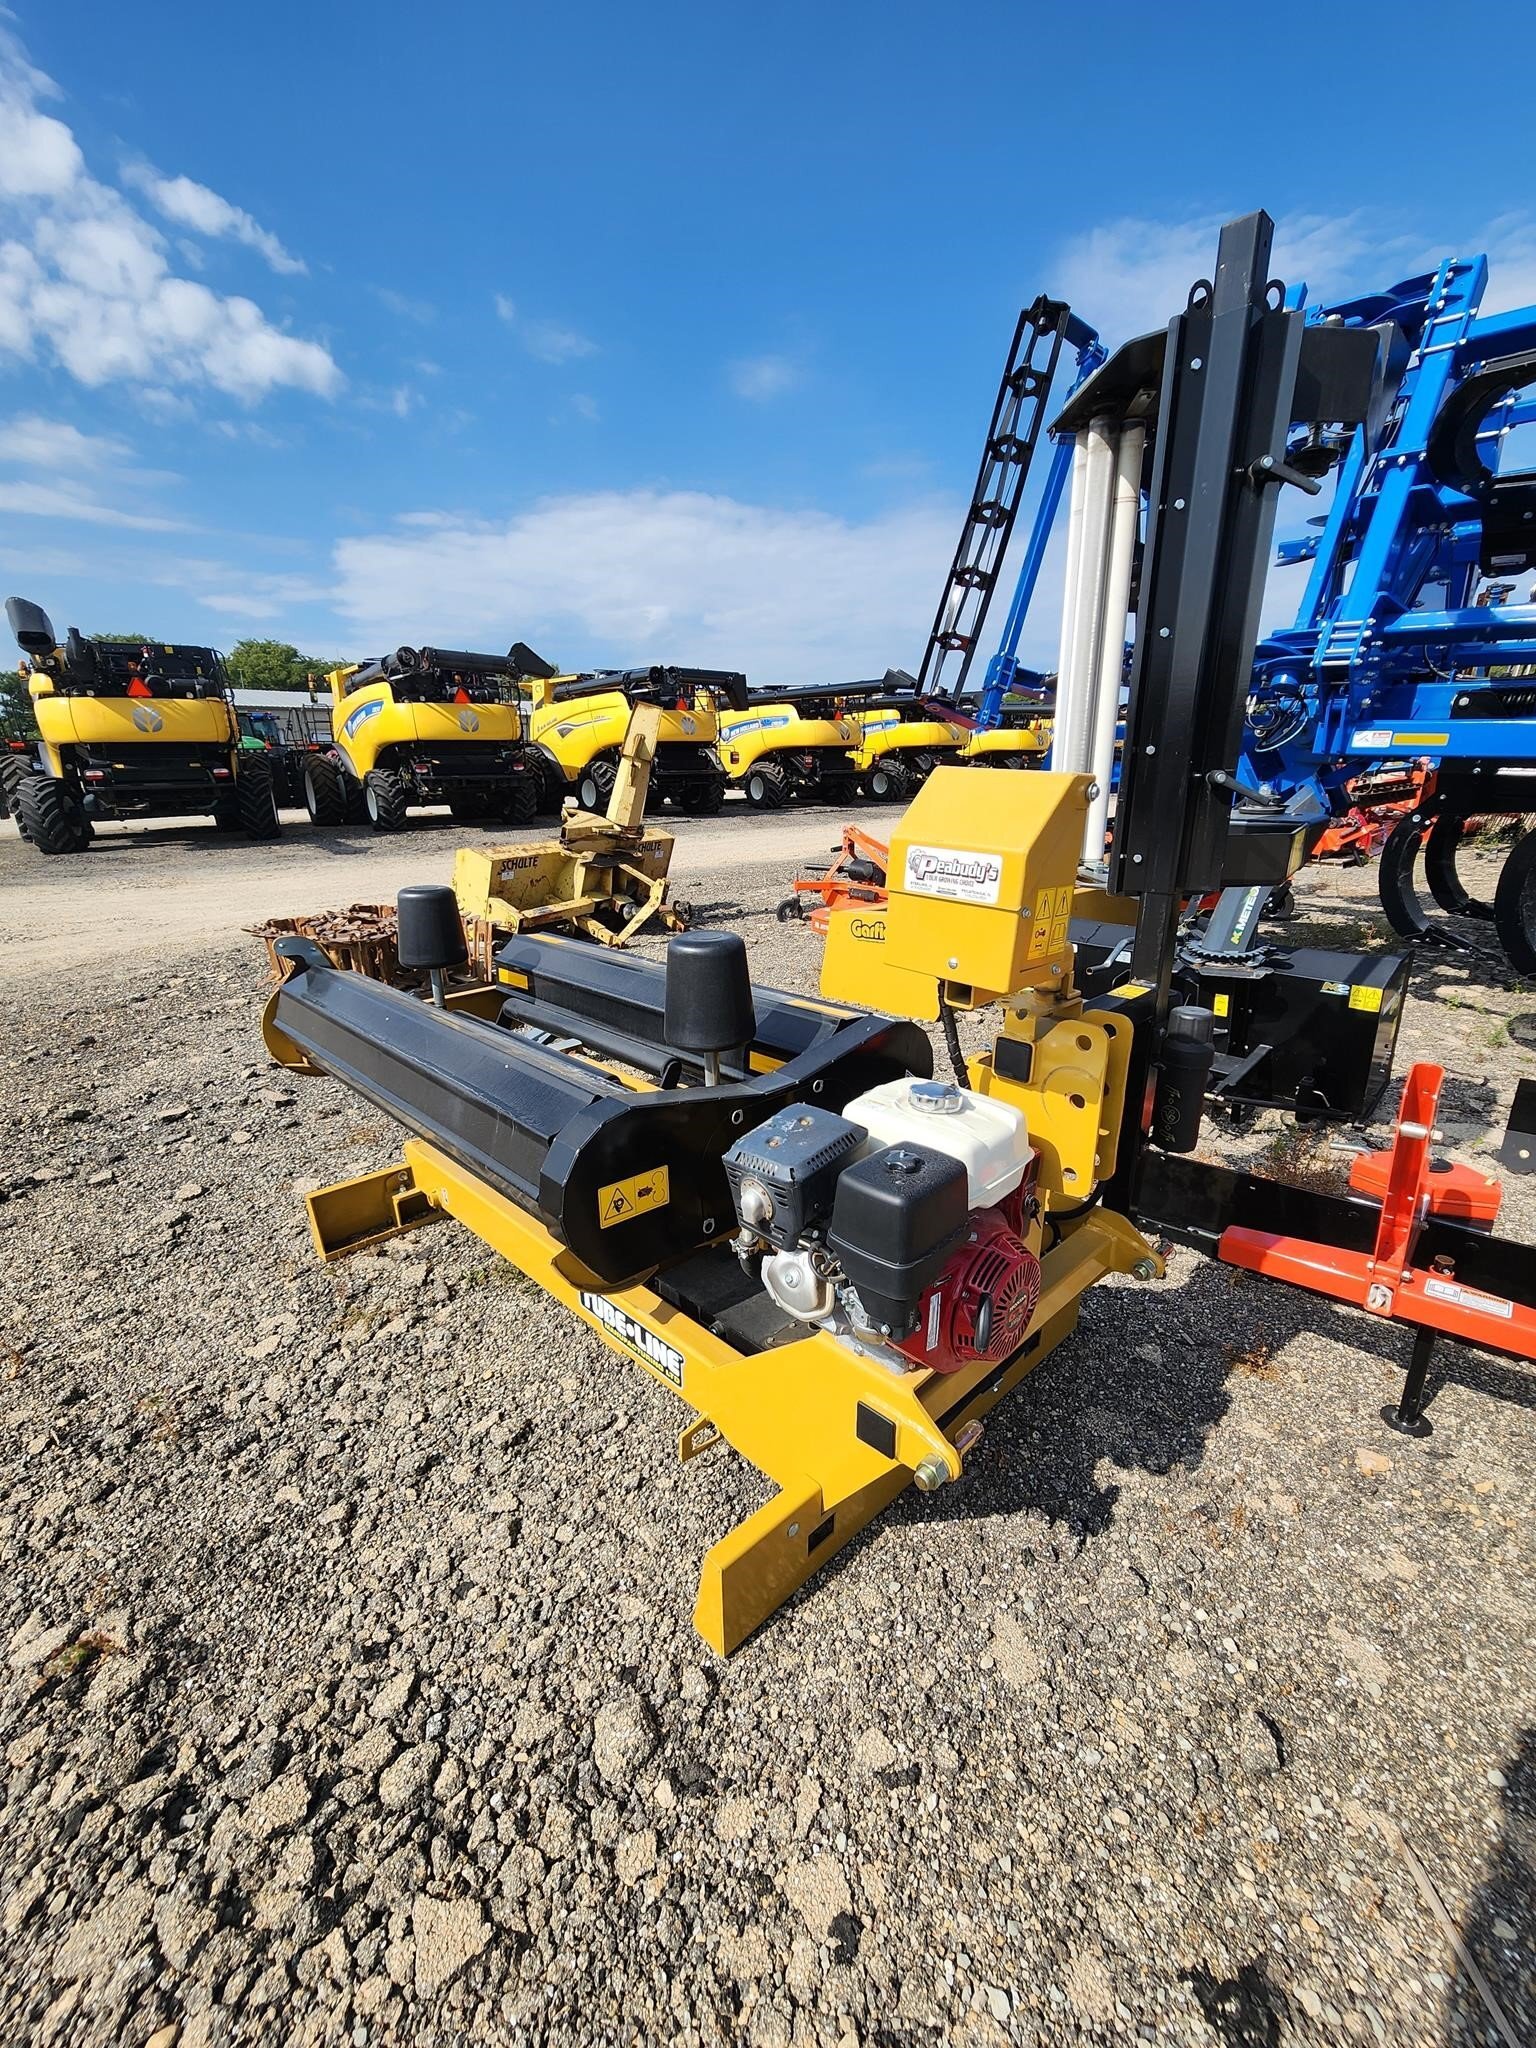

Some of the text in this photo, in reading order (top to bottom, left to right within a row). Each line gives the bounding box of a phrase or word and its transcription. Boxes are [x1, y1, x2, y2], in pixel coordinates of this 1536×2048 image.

[501, 857, 539, 872] SCHULTE
[916, 854, 998, 883] Peabudy's
[1235, 886, 1262, 931] METEO
[851, 919, 886, 941] Garfi
[605, 1323, 681, 1384] MANUFACTURING LTD
